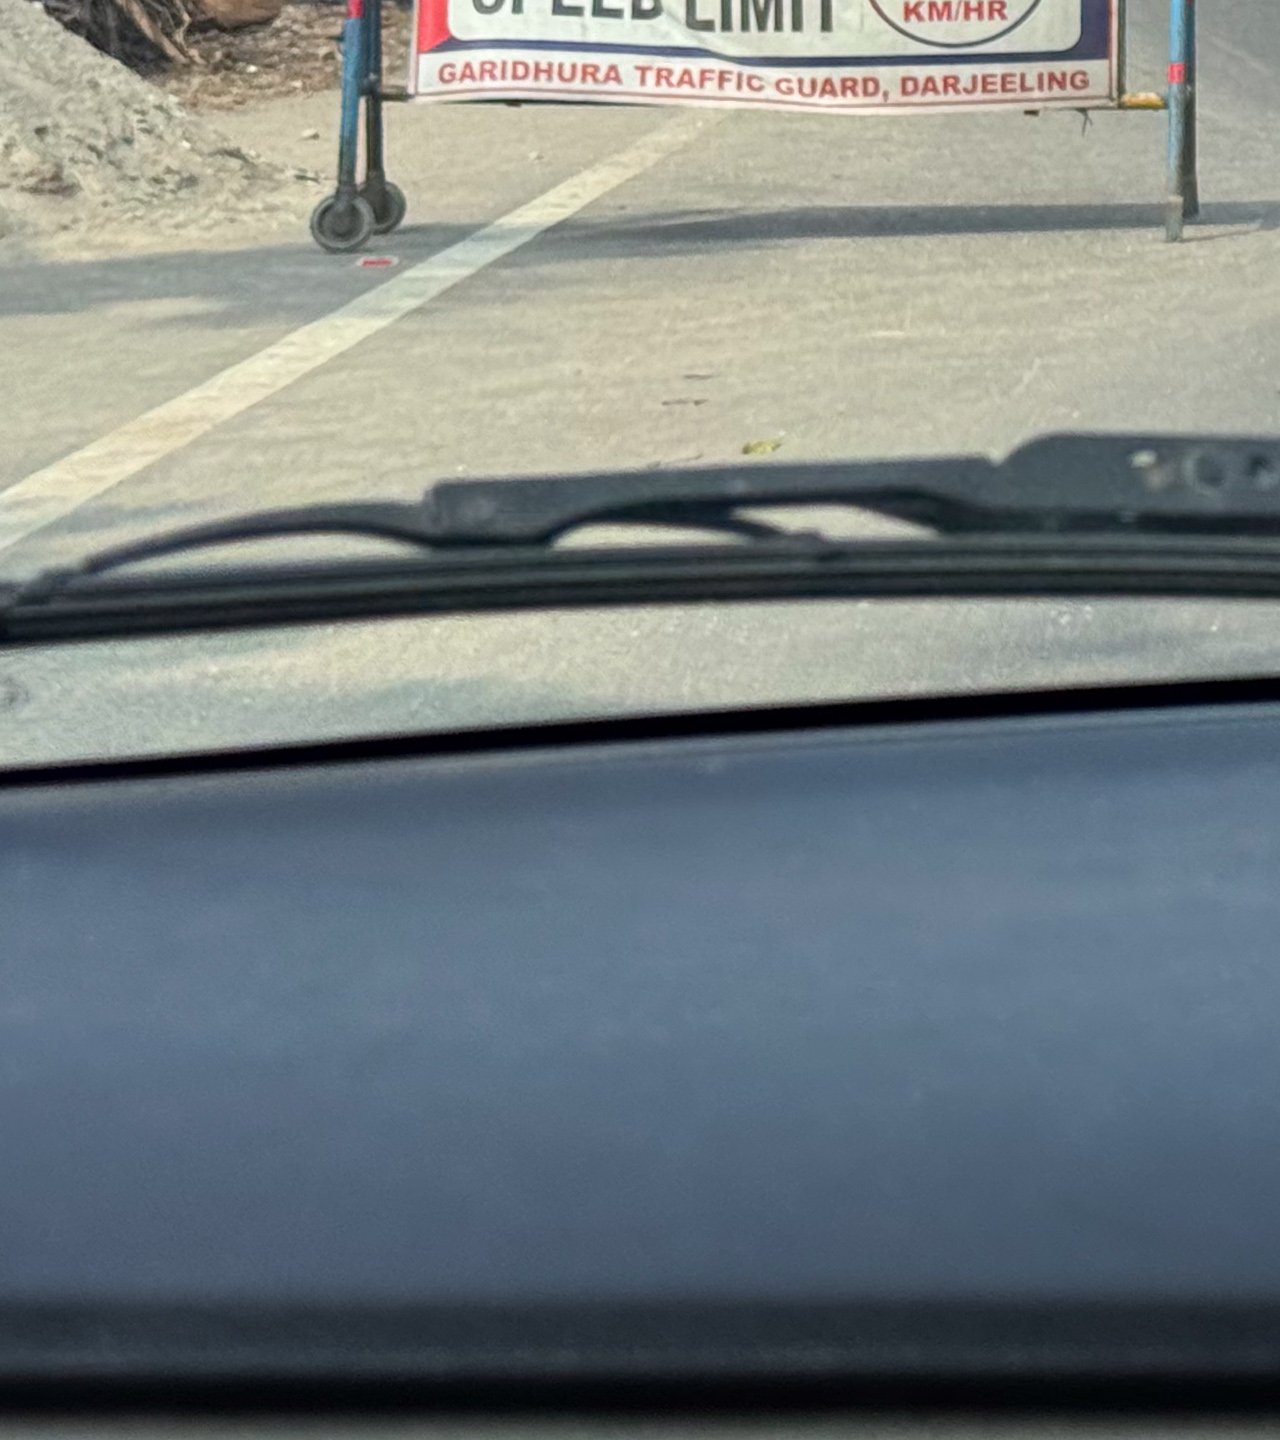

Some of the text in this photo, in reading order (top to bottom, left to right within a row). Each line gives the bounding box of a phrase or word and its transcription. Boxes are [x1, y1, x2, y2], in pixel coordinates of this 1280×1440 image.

[438, 61, 1090, 103] GARIDHURA TRAFFIC GUARD, DARJEELING
